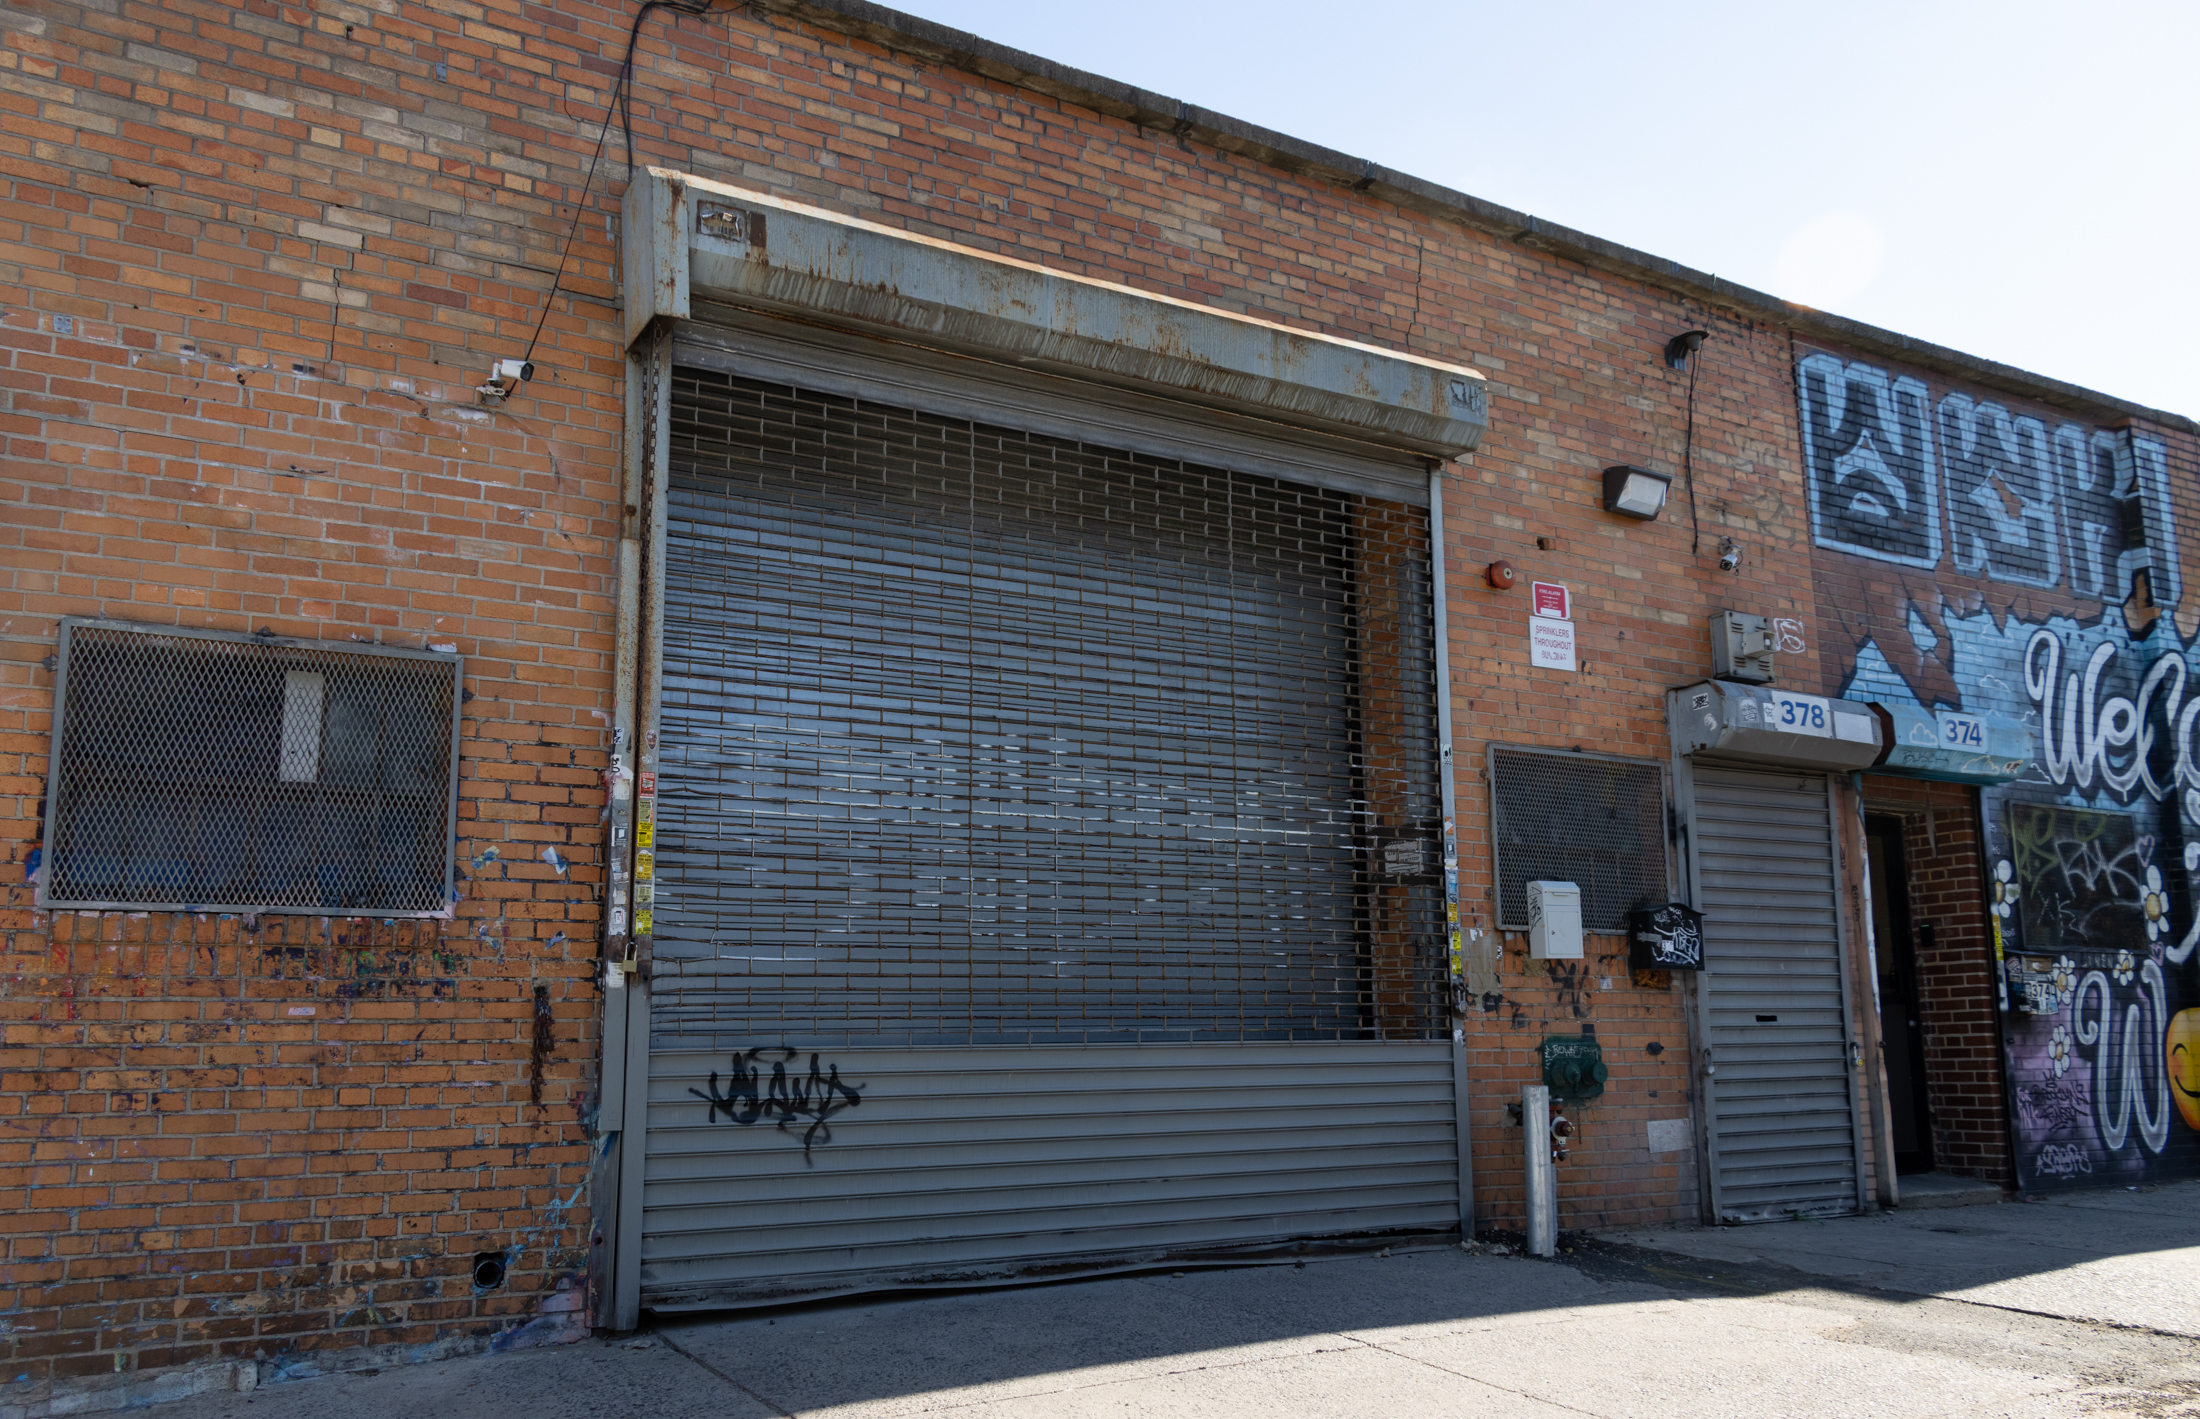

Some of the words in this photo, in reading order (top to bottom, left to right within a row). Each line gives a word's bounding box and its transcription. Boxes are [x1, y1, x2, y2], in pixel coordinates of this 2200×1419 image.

[1535, 625, 1569, 638] SPRINKLERS
[1534, 637, 1571, 650] THROUGHOUT
[1780, 700, 1825, 729] 378
[1945, 719, 1982, 746] 374
[2031, 983, 2053, 998] 374
